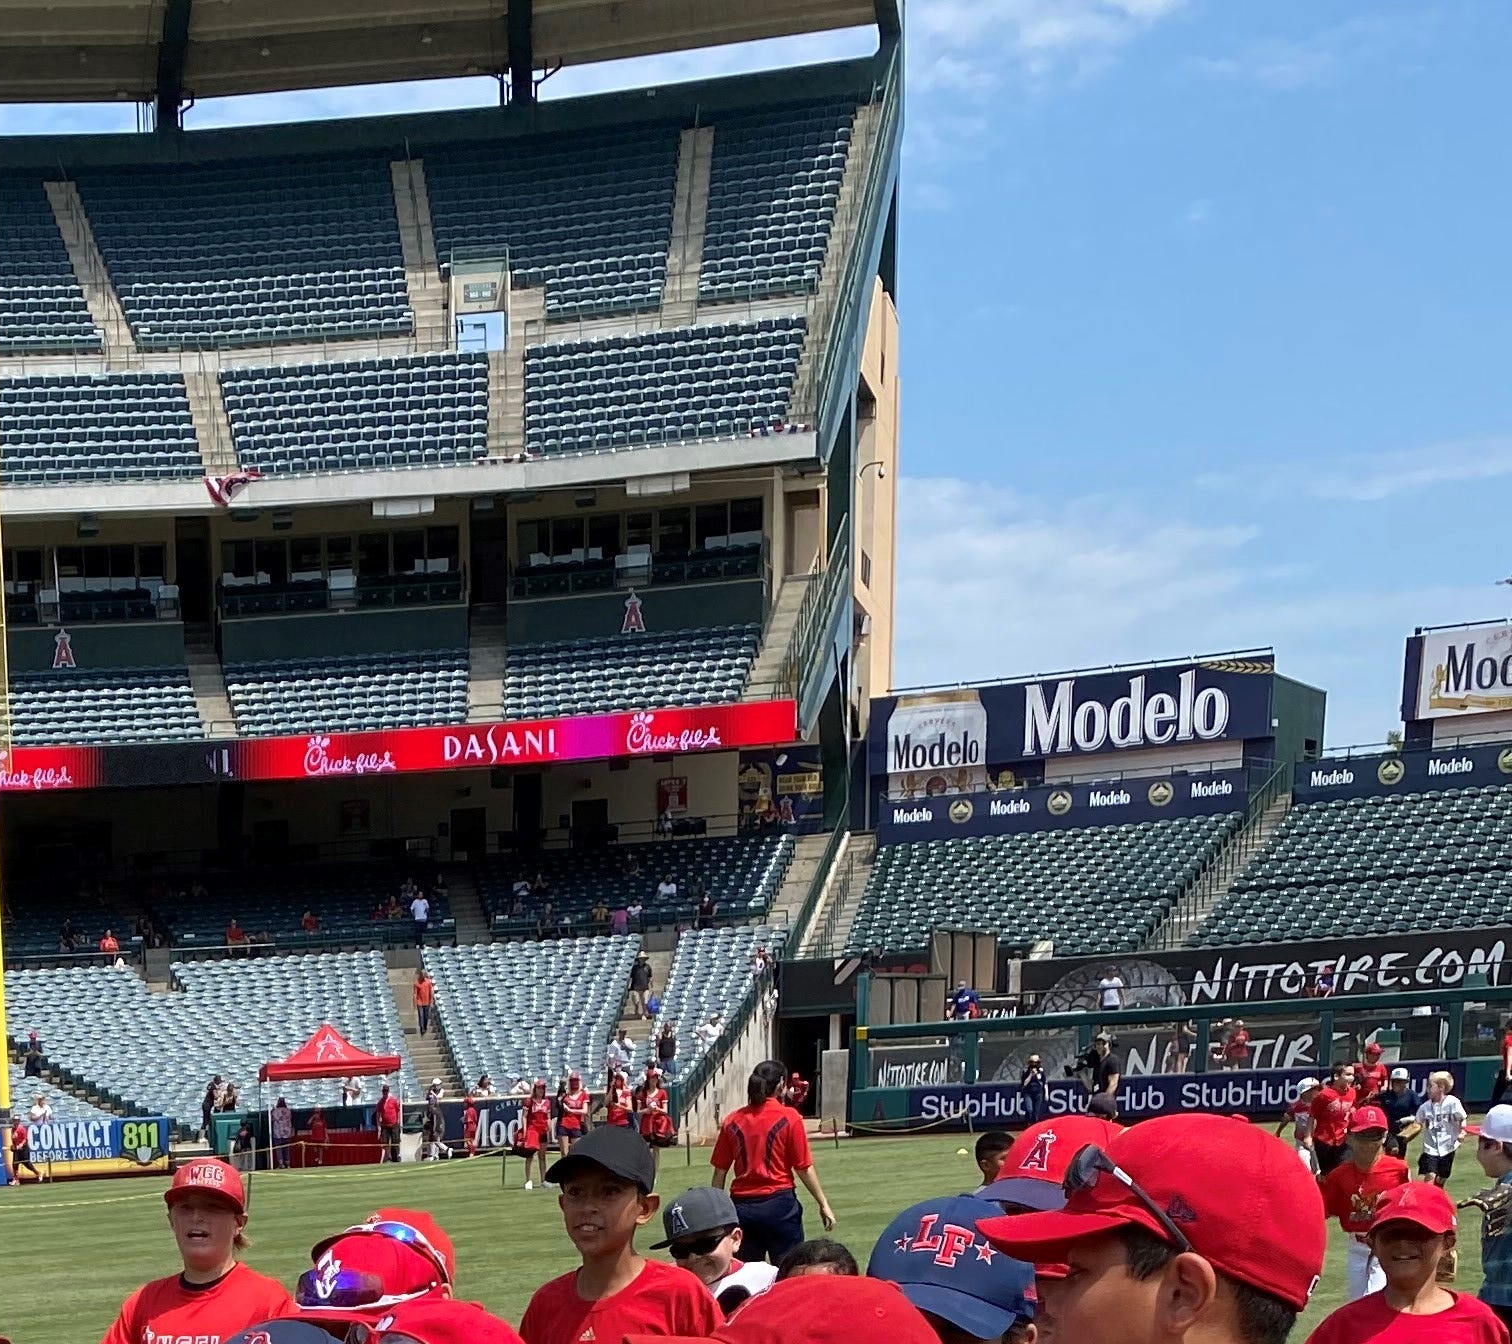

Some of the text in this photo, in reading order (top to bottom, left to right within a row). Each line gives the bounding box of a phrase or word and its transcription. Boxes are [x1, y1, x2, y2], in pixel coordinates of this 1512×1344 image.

[1021, 668, 1230, 757] Modelo
[304, 736, 397, 776] Chick-fil-A
[445, 724, 556, 765] DASANI
[626, 712, 722, 754] Chick-fil-A
[893, 730, 979, 770] Modelo
[1428, 756, 1474, 777] Modelo
[1310, 768, 1354, 788] Modelo
[1089, 791, 1131, 808] Modelo
[1191, 780, 1233, 798] Modelo
[893, 808, 933, 824] Modelo
[989, 799, 1031, 816] Modelo
[28, 1121, 112, 1151] CONTACT
[123, 1123, 158, 1150] 811
[30, 1146, 112, 1164] BEFORE YOU DIG
[909, 1213, 976, 1268] LF
